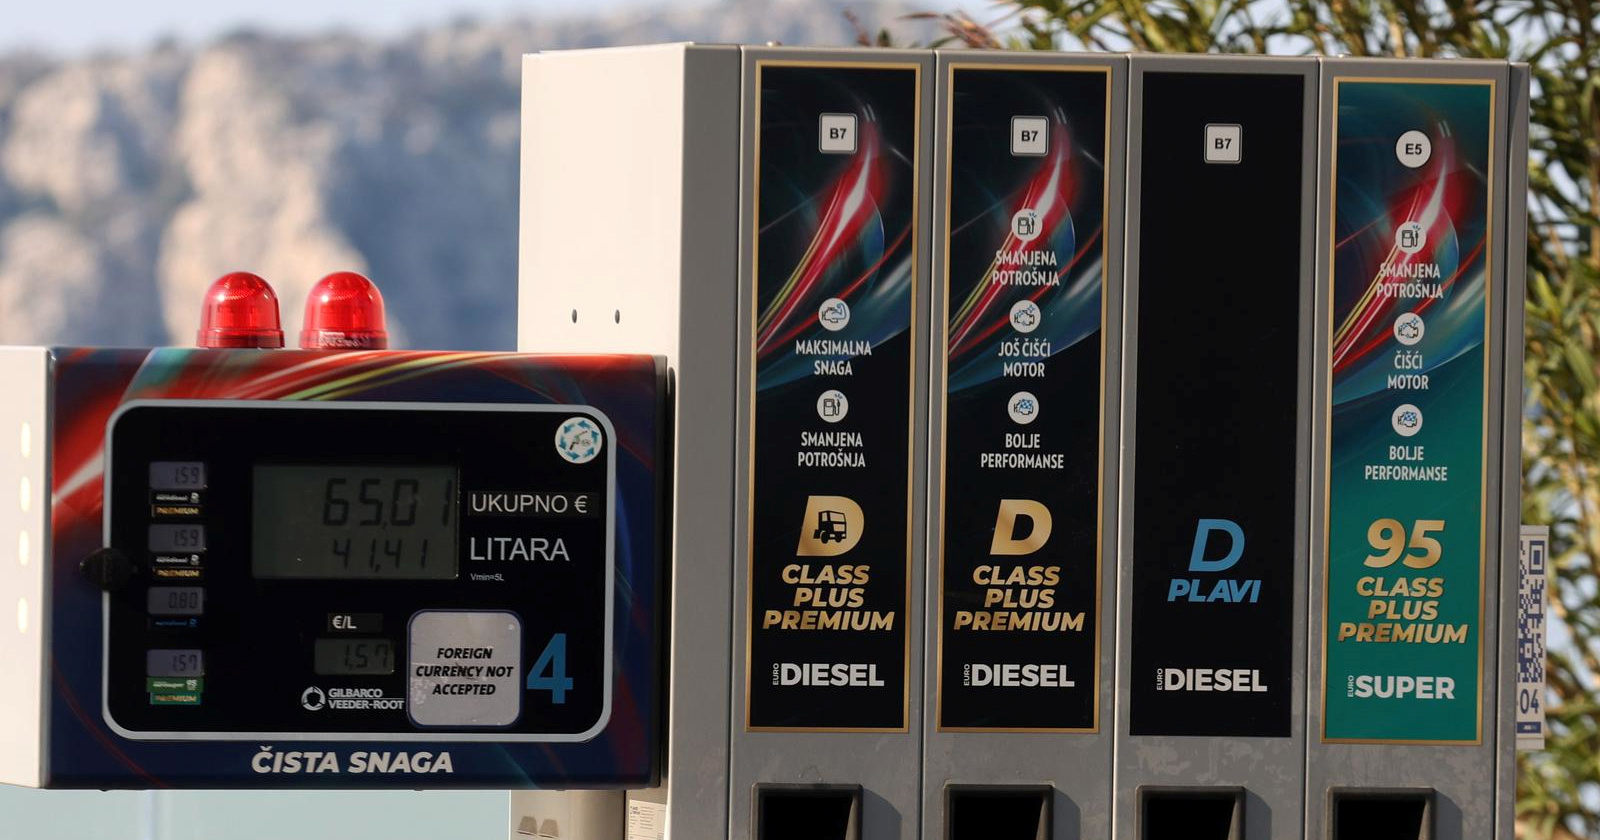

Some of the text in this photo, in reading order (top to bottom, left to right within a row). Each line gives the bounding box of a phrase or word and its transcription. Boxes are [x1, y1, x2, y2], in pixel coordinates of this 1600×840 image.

[830, 127, 847, 141] B7
[1021, 130, 1038, 142] B7
[1214, 138, 1232, 150] B7
[1405, 143, 1422, 156] E5
[995, 250, 1057, 266] SMANJENA
[992, 266, 1060, 286] POTROŠNJA
[1379, 263, 1440, 279] SMANJENA
[1376, 279, 1444, 299] POTROŠNJA
[795, 340, 872, 356] MAKSIMALNA
[998, 337, 1051, 357] JOŠ ČIŠĆI
[814, 360, 852, 376] SNAGA
[1003, 362, 1045, 378] MOTOR
[1394, 350, 1423, 370] ČIŠĆI
[1387, 374, 1429, 390] MOTOR
[801, 432, 863, 448] SMANJENA
[1005, 433, 1041, 450] BOLJE
[798, 447, 866, 468] POTROŠNJA
[981, 453, 1064, 470] PERFORMANSE
[1389, 446, 1424, 462] BOLJE
[1365, 465, 1448, 481] PERFORMANSE
[471, 493, 588, 515] UKUPNO €
[990, 499, 1053, 556] D
[470, 537, 570, 562] LITARA
[1188, 518, 1245, 572] D
[1363, 518, 1446, 569] 95
[470, 573, 504, 582] Vmin=5L
[782, 564, 870, 585] CLASS
[973, 565, 1060, 586] CLASS
[793, 587, 864, 608] PLUS
[1167, 579, 1262, 604] PLAVI
[1356, 577, 1444, 598] CLASS
[984, 588, 1055, 609] PLUS
[1368, 600, 1439, 620] PLUS
[332, 616, 357, 630] €/L
[762, 610, 895, 631] PREMIUM
[953, 611, 1086, 632] PREMIUM
[1338, 622, 1468, 644] PREMIUM
[437, 647, 492, 660] FOREIGN
[416, 665, 513, 678] CURRENCY NOT
[526, 632, 573, 705] 4
[780, 663, 885, 687] DIESEL
[972, 663, 1075, 688] DIESEL
[432, 683, 496, 696] ACCEPTED
[1164, 668, 1268, 692] DIESEL
[1355, 675, 1455, 700] SUPER
[328, 687, 383, 699] GILBARCO
[328, 699, 404, 711] VEEDER-ROOT
[251, 745, 454, 774] ČISTA SNAGA
